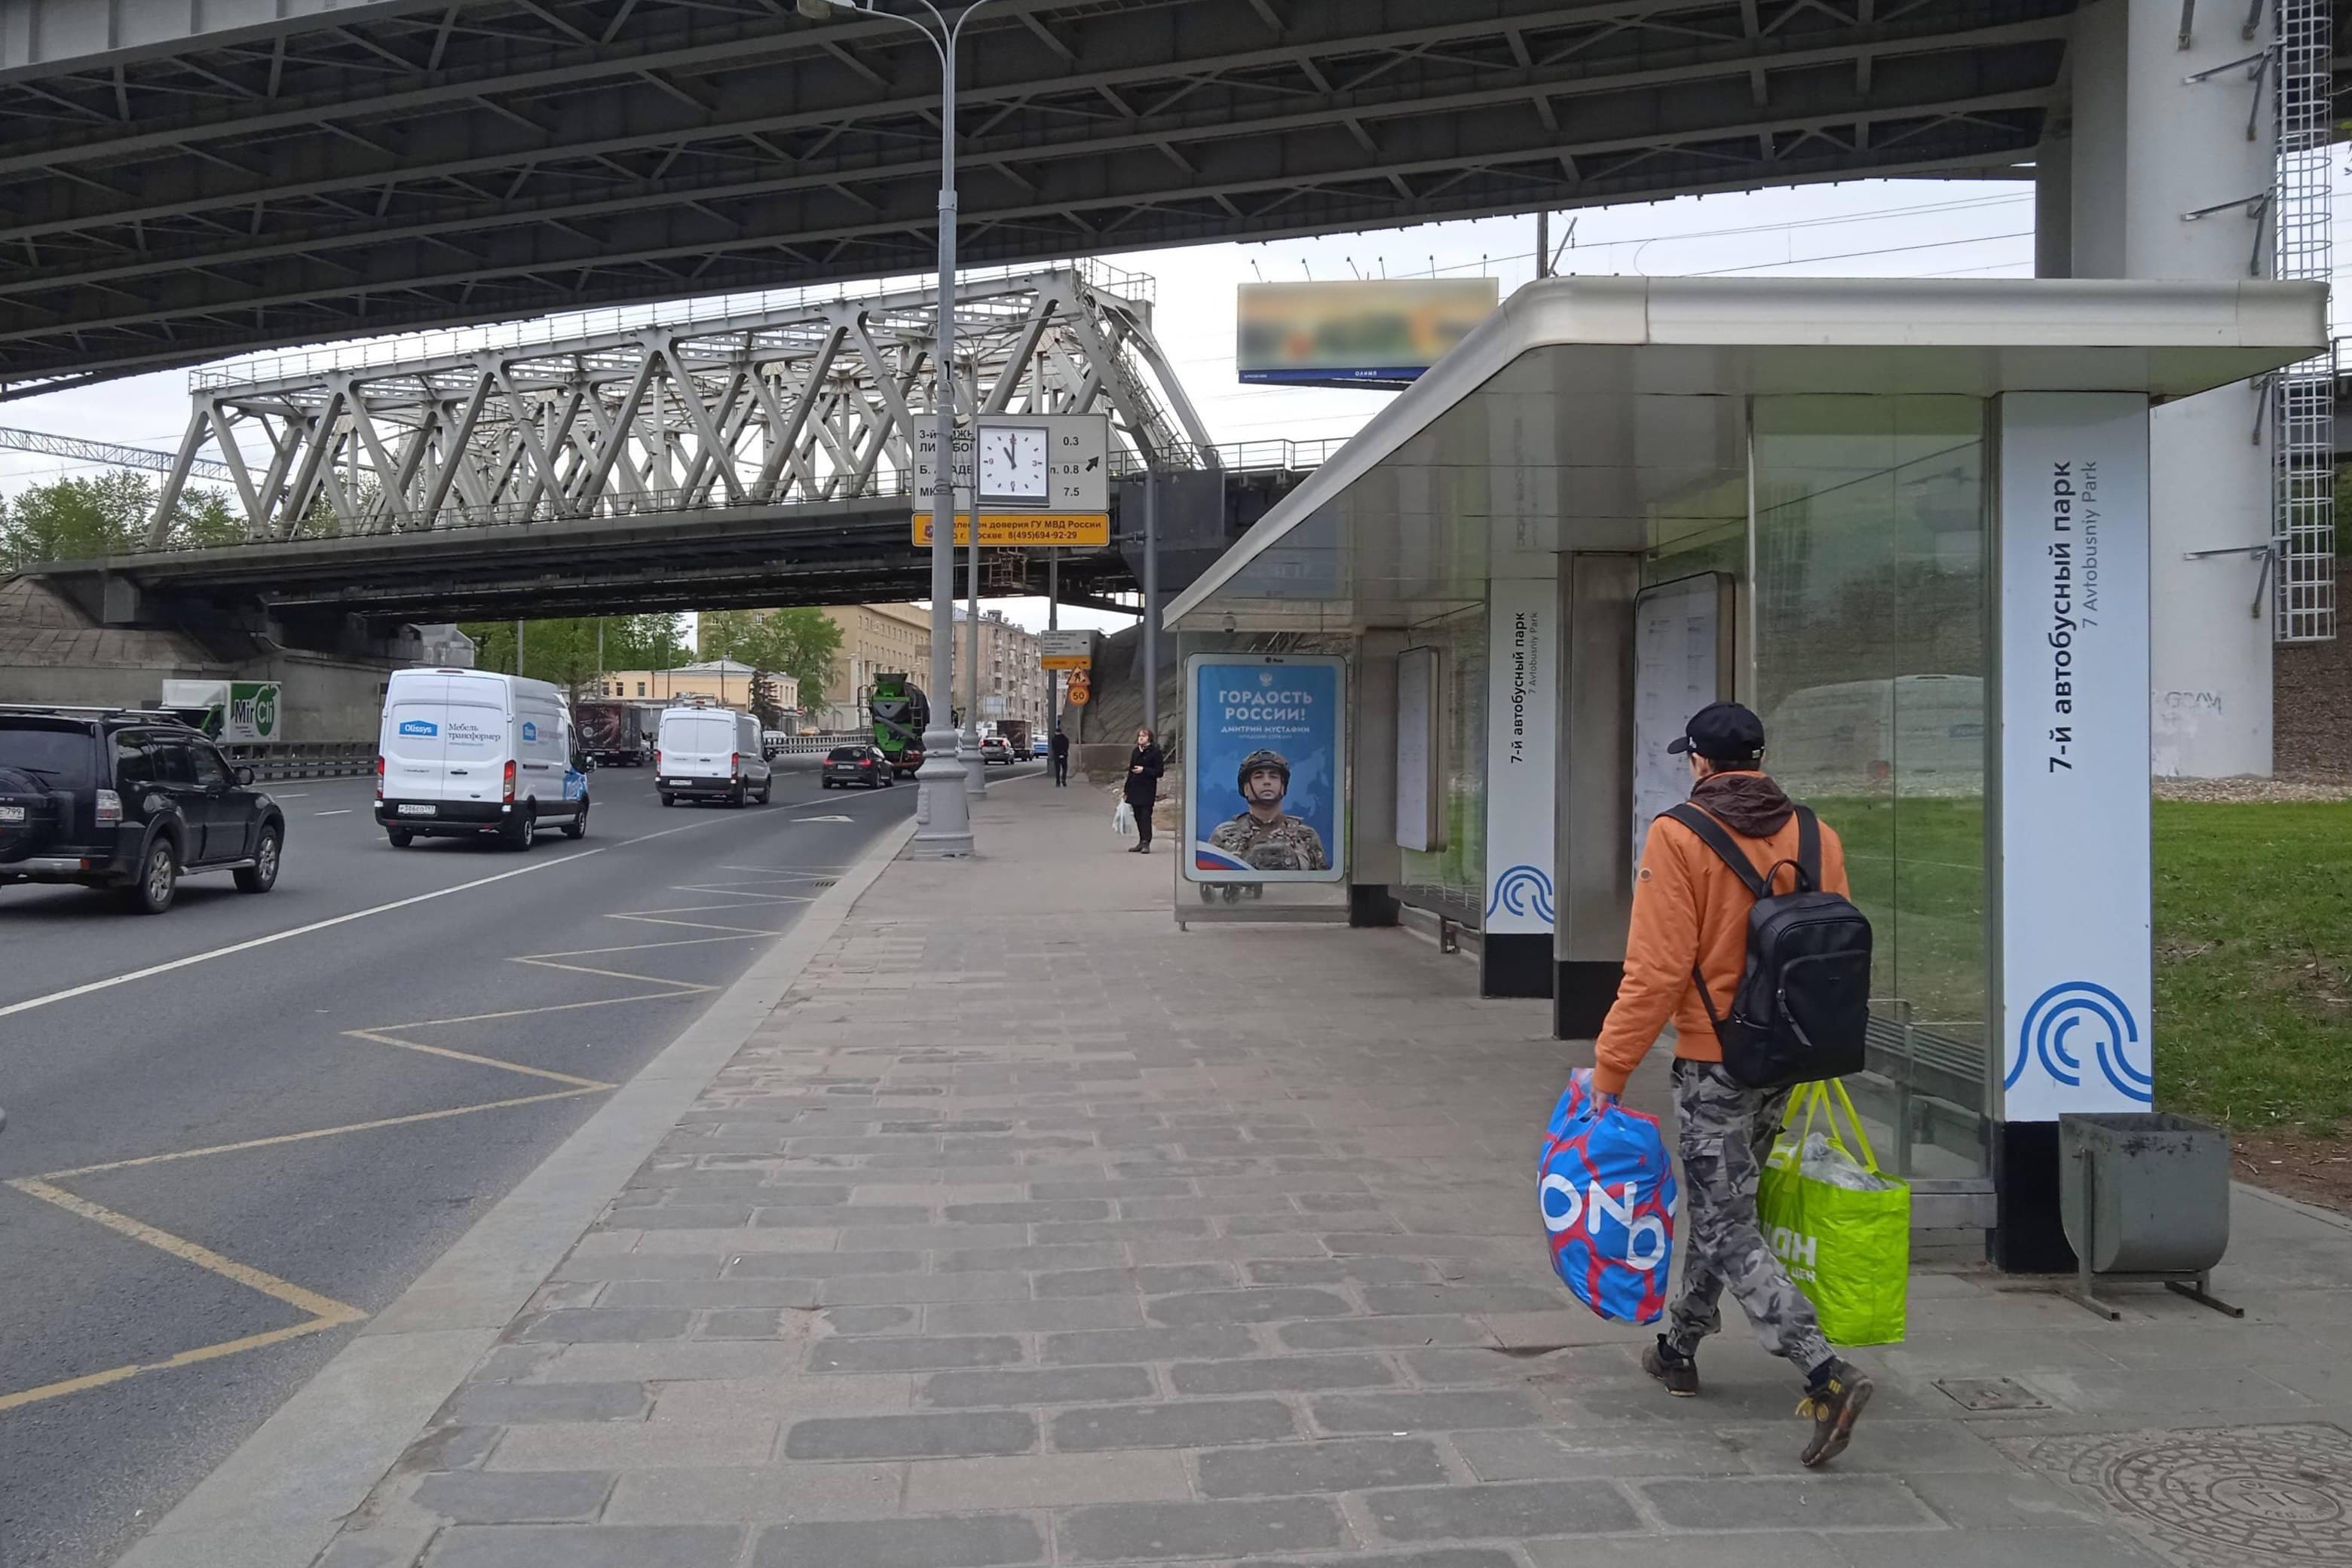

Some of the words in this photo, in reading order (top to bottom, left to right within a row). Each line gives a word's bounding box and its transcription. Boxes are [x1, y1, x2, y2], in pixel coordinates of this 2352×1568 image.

[1063, 436, 1079, 446] 0.3
[1063, 465, 1079, 474] 0.8
[2081, 461, 2098, 503] Park
[1064, 487, 1080, 497] 7.5
[2053, 461, 2076, 531] парк
[1031, 520, 1042, 528] ГУ
[1044, 520, 1065, 529] МВД
[1067, 520, 1101, 528] России
[1008, 531, 1077, 540] 8(495)694-92-29
[2081, 510, 2100, 611] Avtobusniy
[1514, 611, 1527, 647] парк
[1529, 611, 1539, 634] Park
[2047, 542, 2076, 715] автобусный
[2082, 617, 2098, 629] 7
[1528, 635, 1539, 687] Avtobusniy
[1073, 692, 1085, 700] 50
[1219, 690, 1312, 705] ГОРДОСТЬ
[1511, 651, 1527, 736] автобусный
[1225, 707, 1306, 721] РОССИИ!
[405, 724, 432, 734] Olissys
[449, 723, 479, 732] Мебель
[448, 731, 501, 742] трансформер
[1511, 740, 1523, 764] 7-й
[2049, 726, 2072, 773] 7-й
